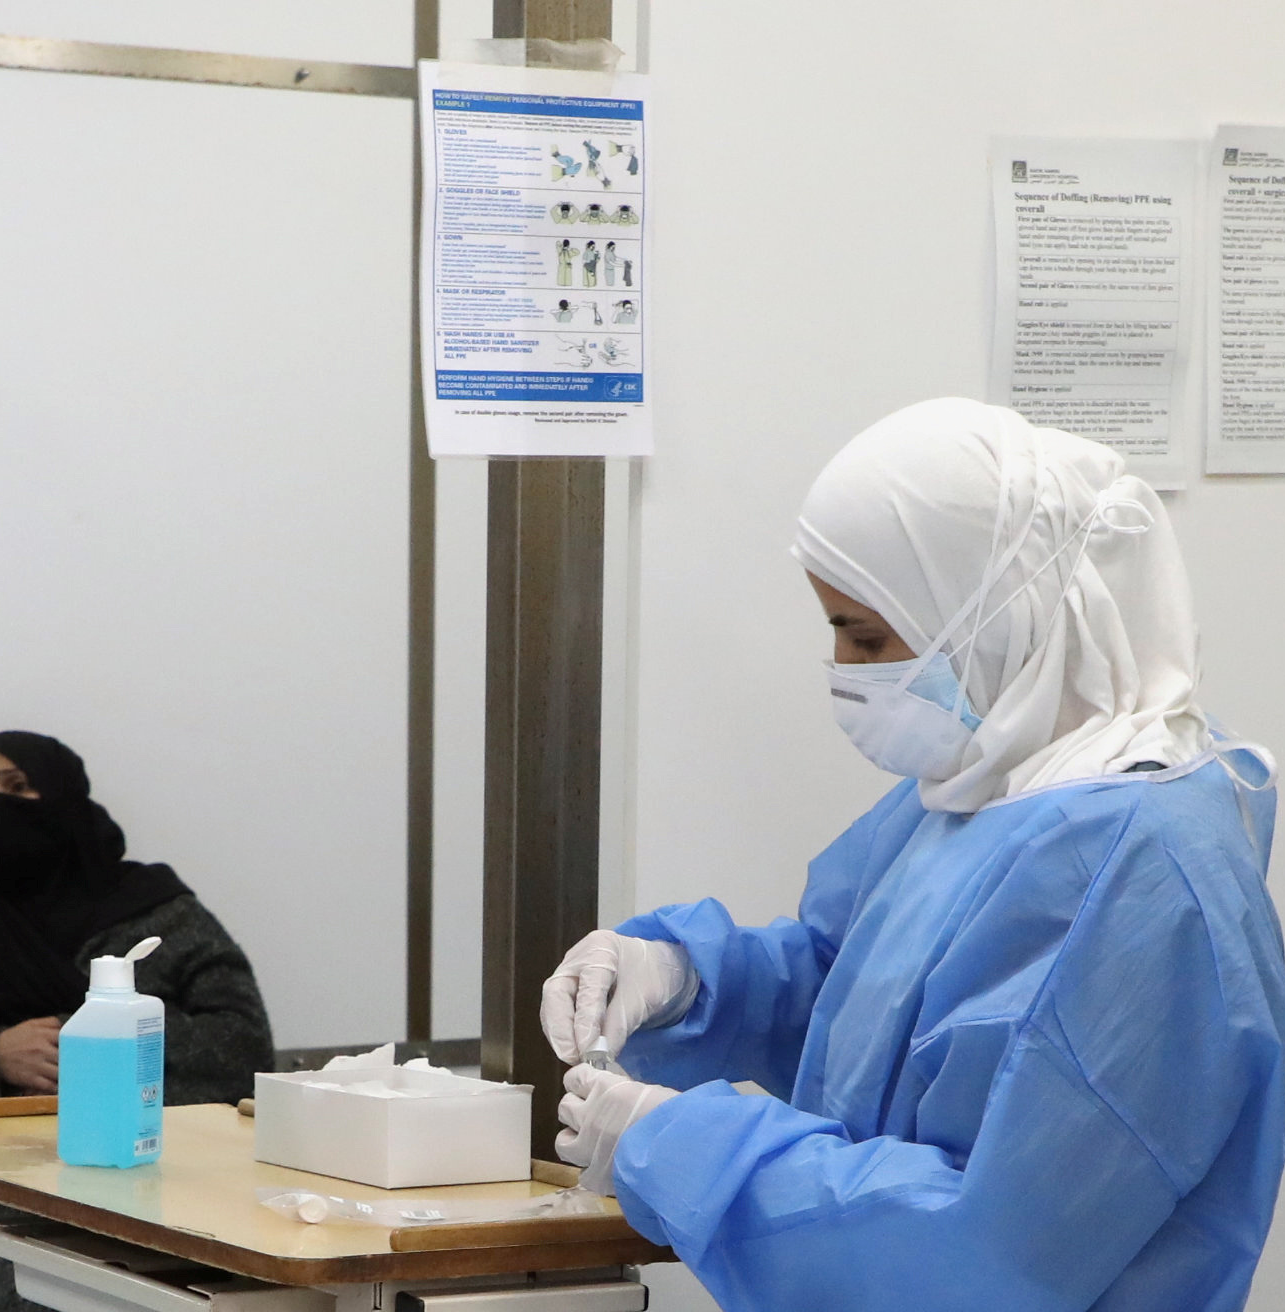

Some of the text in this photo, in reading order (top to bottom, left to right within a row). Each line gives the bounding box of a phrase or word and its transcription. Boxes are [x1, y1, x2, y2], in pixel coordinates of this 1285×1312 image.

[1015, 191, 1172, 206] Sequence of Doffing (Removing) PPE using
[1016, 204, 1045, 213] coverall
